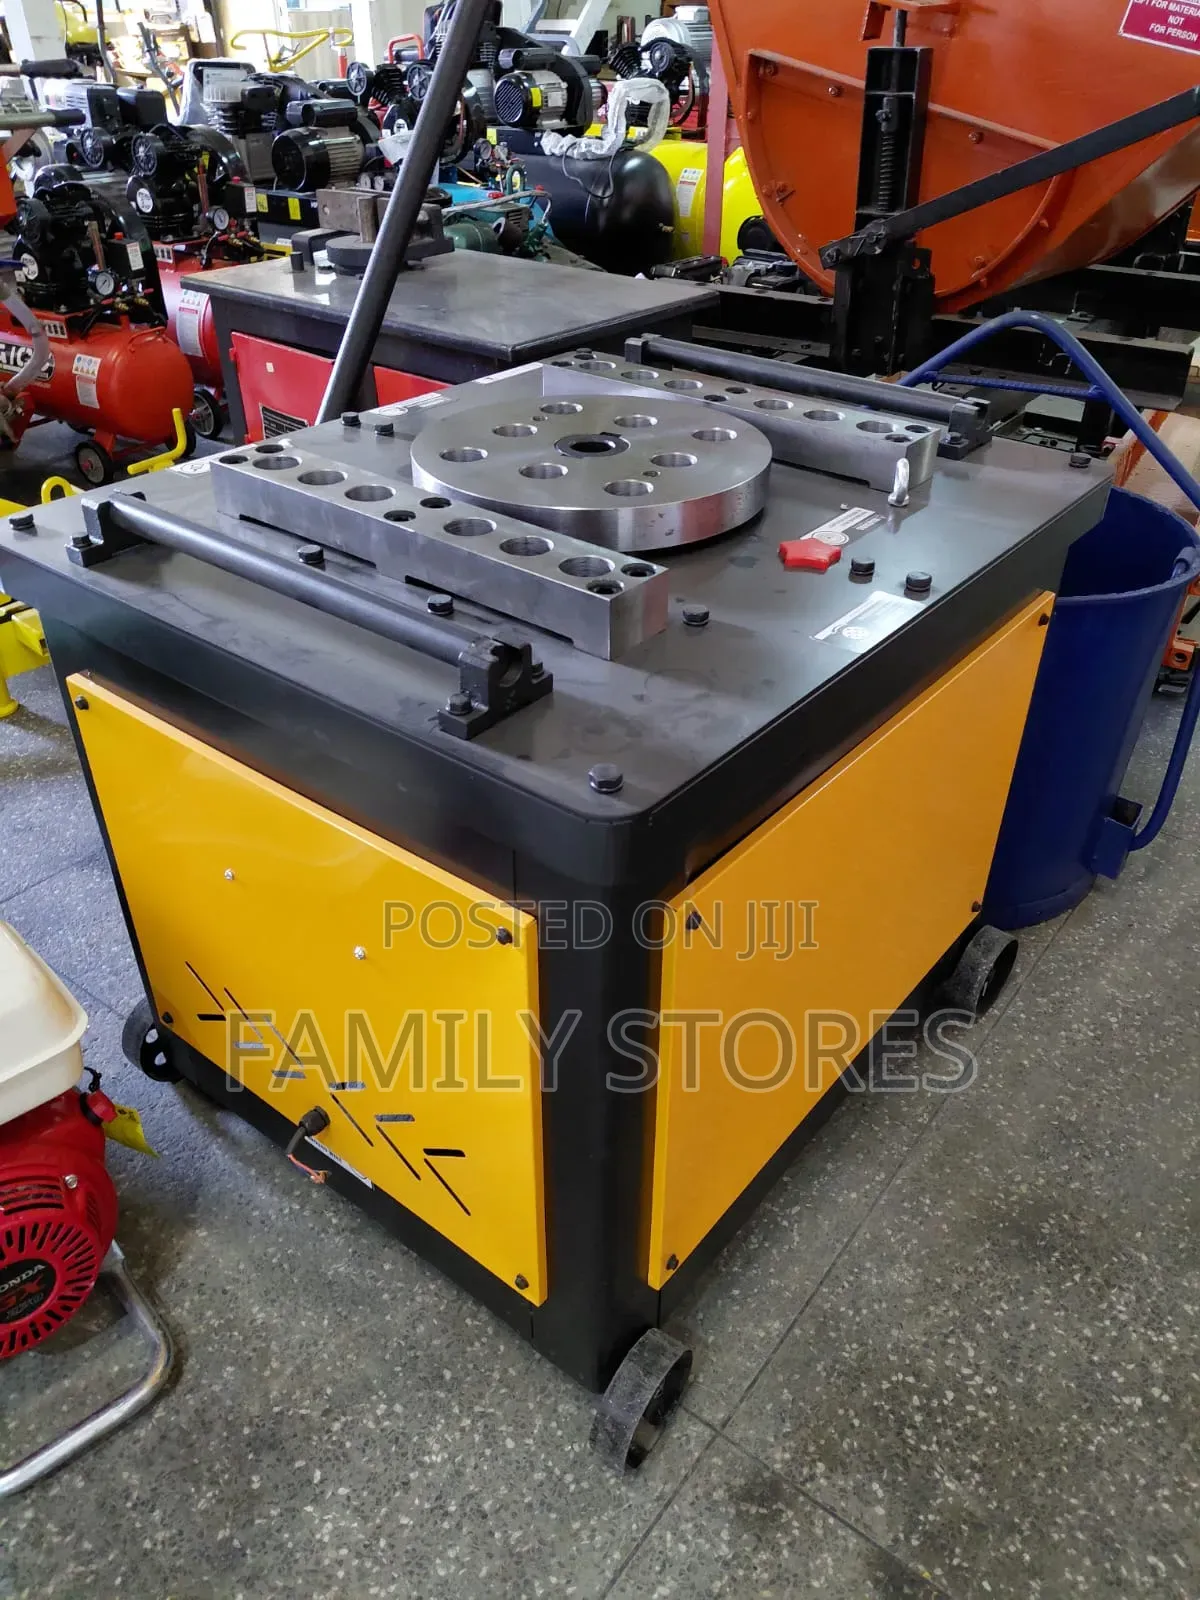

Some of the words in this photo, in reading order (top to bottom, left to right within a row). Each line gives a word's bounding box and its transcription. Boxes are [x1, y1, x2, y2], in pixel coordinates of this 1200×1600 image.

[1151, 0, 1168, 9] FOR
[1168, 15, 1184, 26] NOT
[1149, 23, 1167, 34] FOR
[1166, 27, 1199, 42] PERSON
[0, 1264, 46, 1293] ONDA
